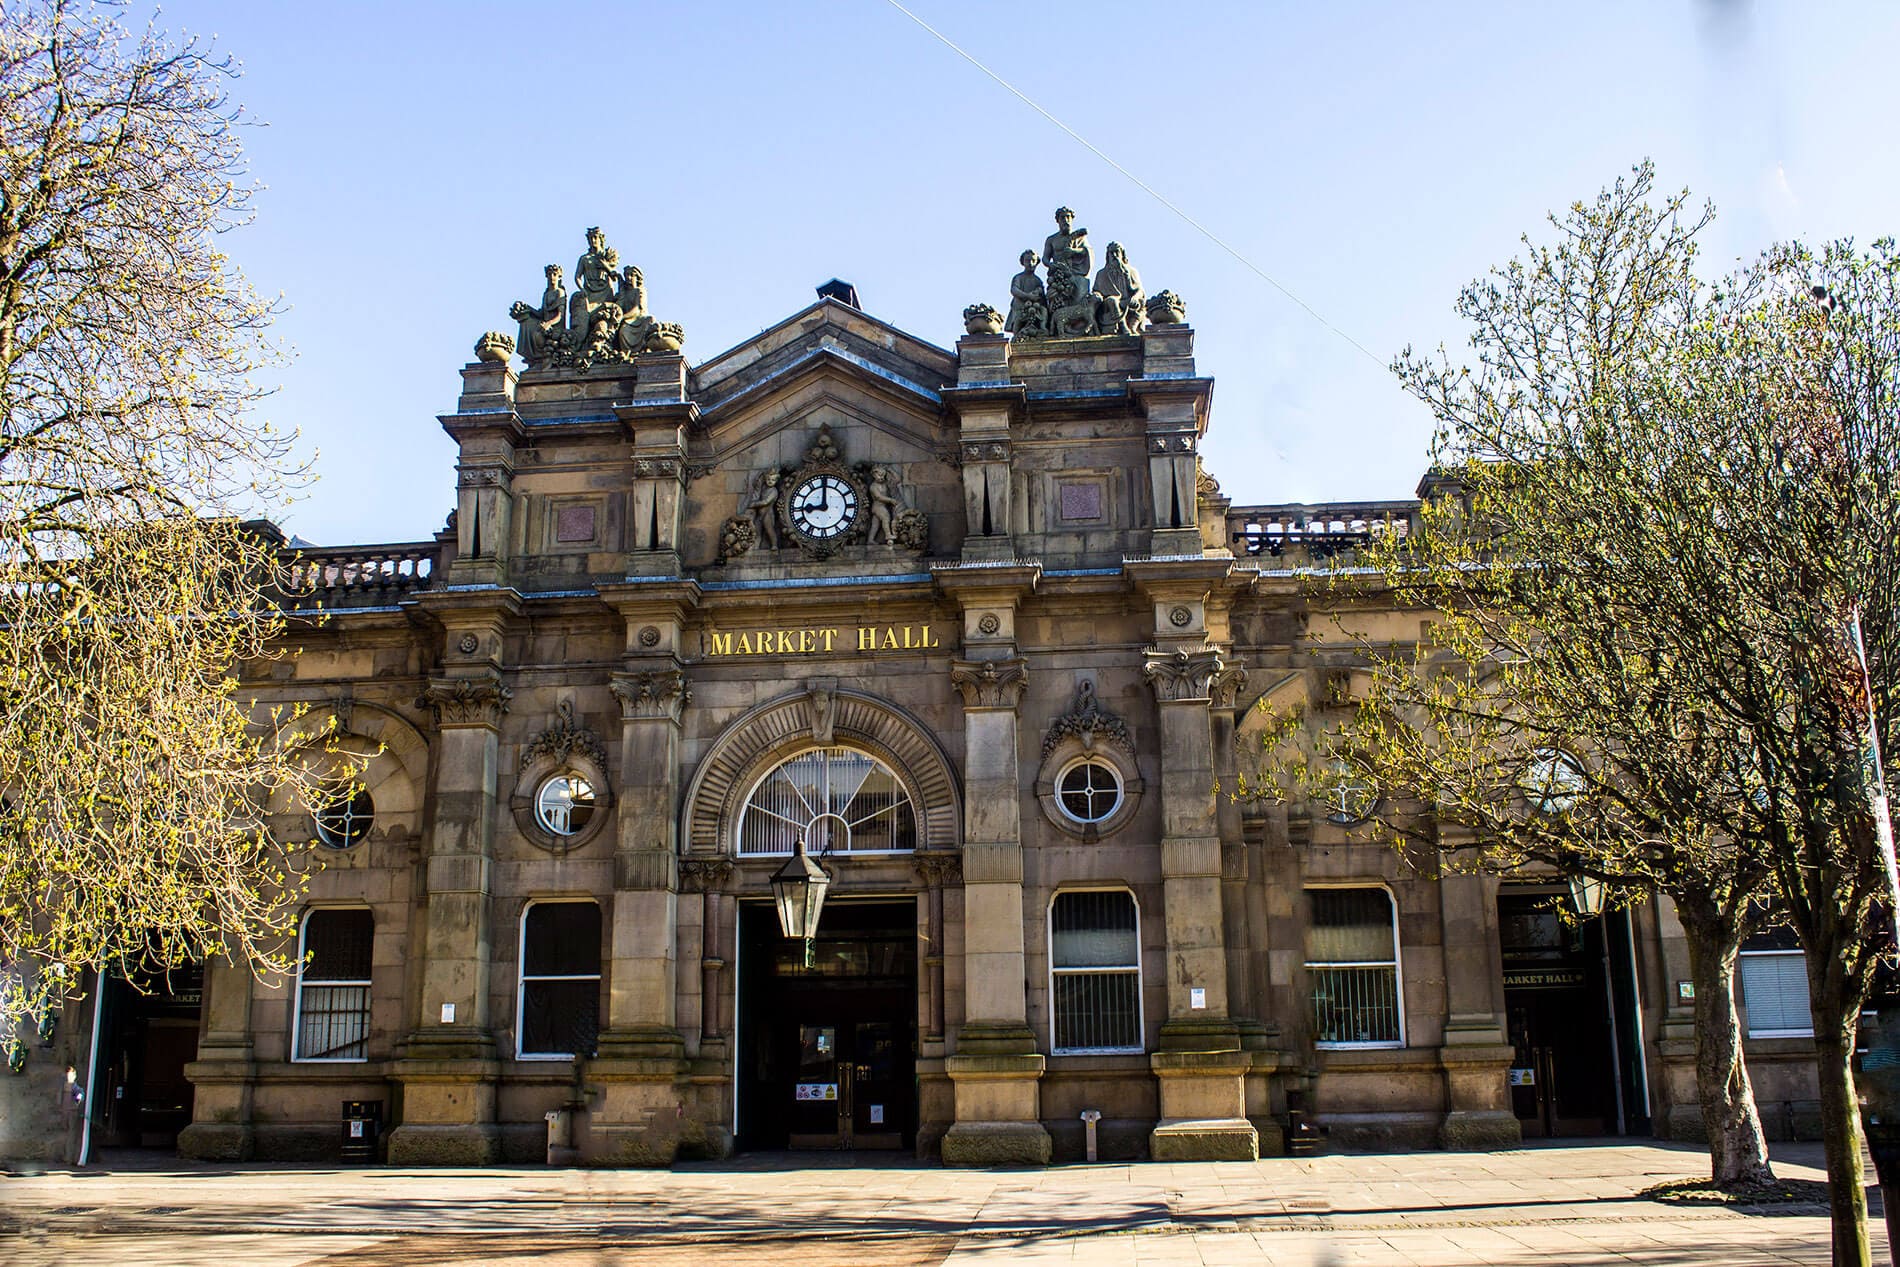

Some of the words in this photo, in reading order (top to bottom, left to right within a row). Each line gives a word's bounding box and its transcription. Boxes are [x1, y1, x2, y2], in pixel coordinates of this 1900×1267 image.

[710, 628, 838, 656] MARKET
[857, 625, 939, 650] HALL
[1546, 974, 1574, 983] HALL
